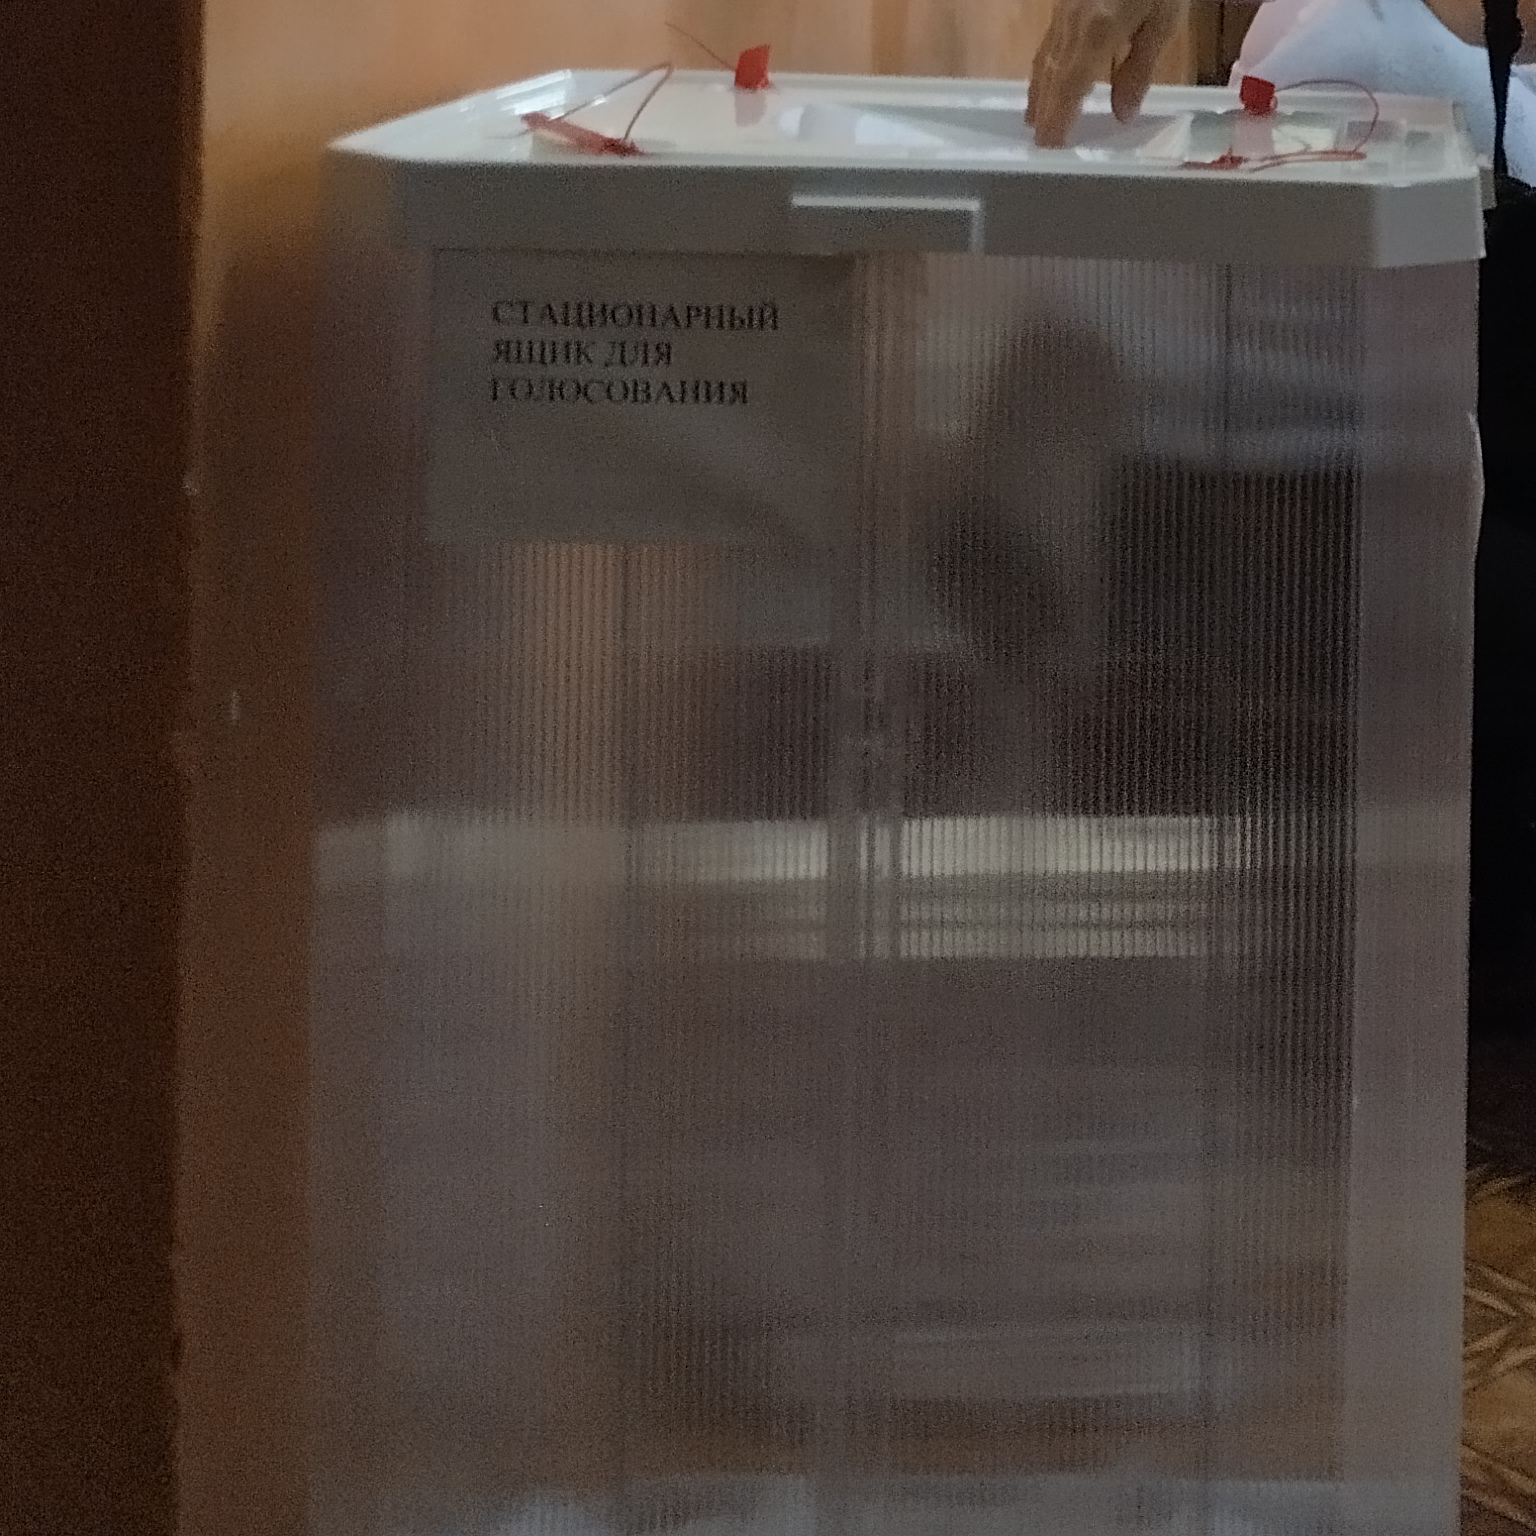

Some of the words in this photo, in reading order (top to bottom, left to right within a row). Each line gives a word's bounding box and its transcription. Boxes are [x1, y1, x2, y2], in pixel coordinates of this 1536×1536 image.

[491, 300, 779, 331] СТАЦИОНАРНЫЙ
[493, 339, 595, 366] ЯЩИК
[604, 340, 672, 368] ДЛЯ
[490, 377, 749, 405] ГОЛОСОВАНИЯ
